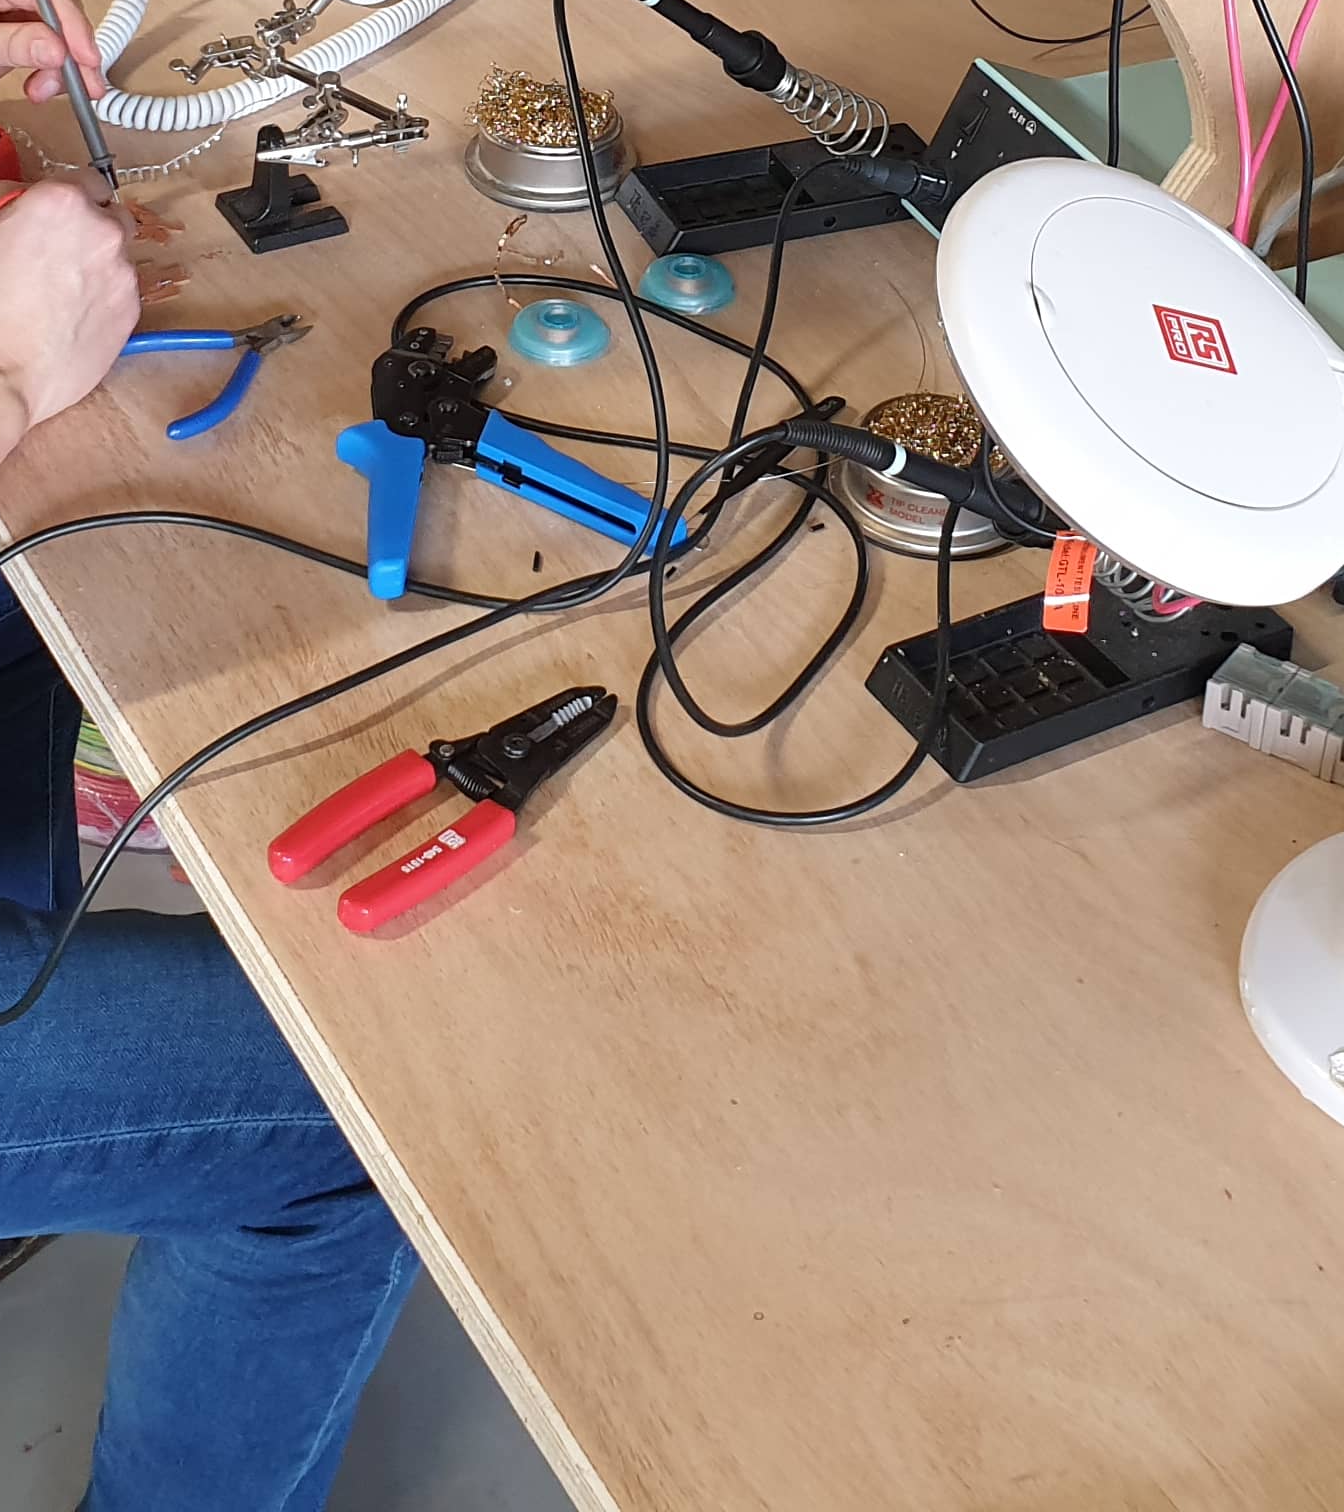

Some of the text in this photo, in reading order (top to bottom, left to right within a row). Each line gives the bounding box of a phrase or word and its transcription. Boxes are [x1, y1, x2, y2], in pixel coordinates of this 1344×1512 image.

[1165, 315, 1189, 356] PRO
[1185, 321, 1224, 363] RS
[889, 496, 906, 507] TIP
[889, 507, 926, 525] MODEL
